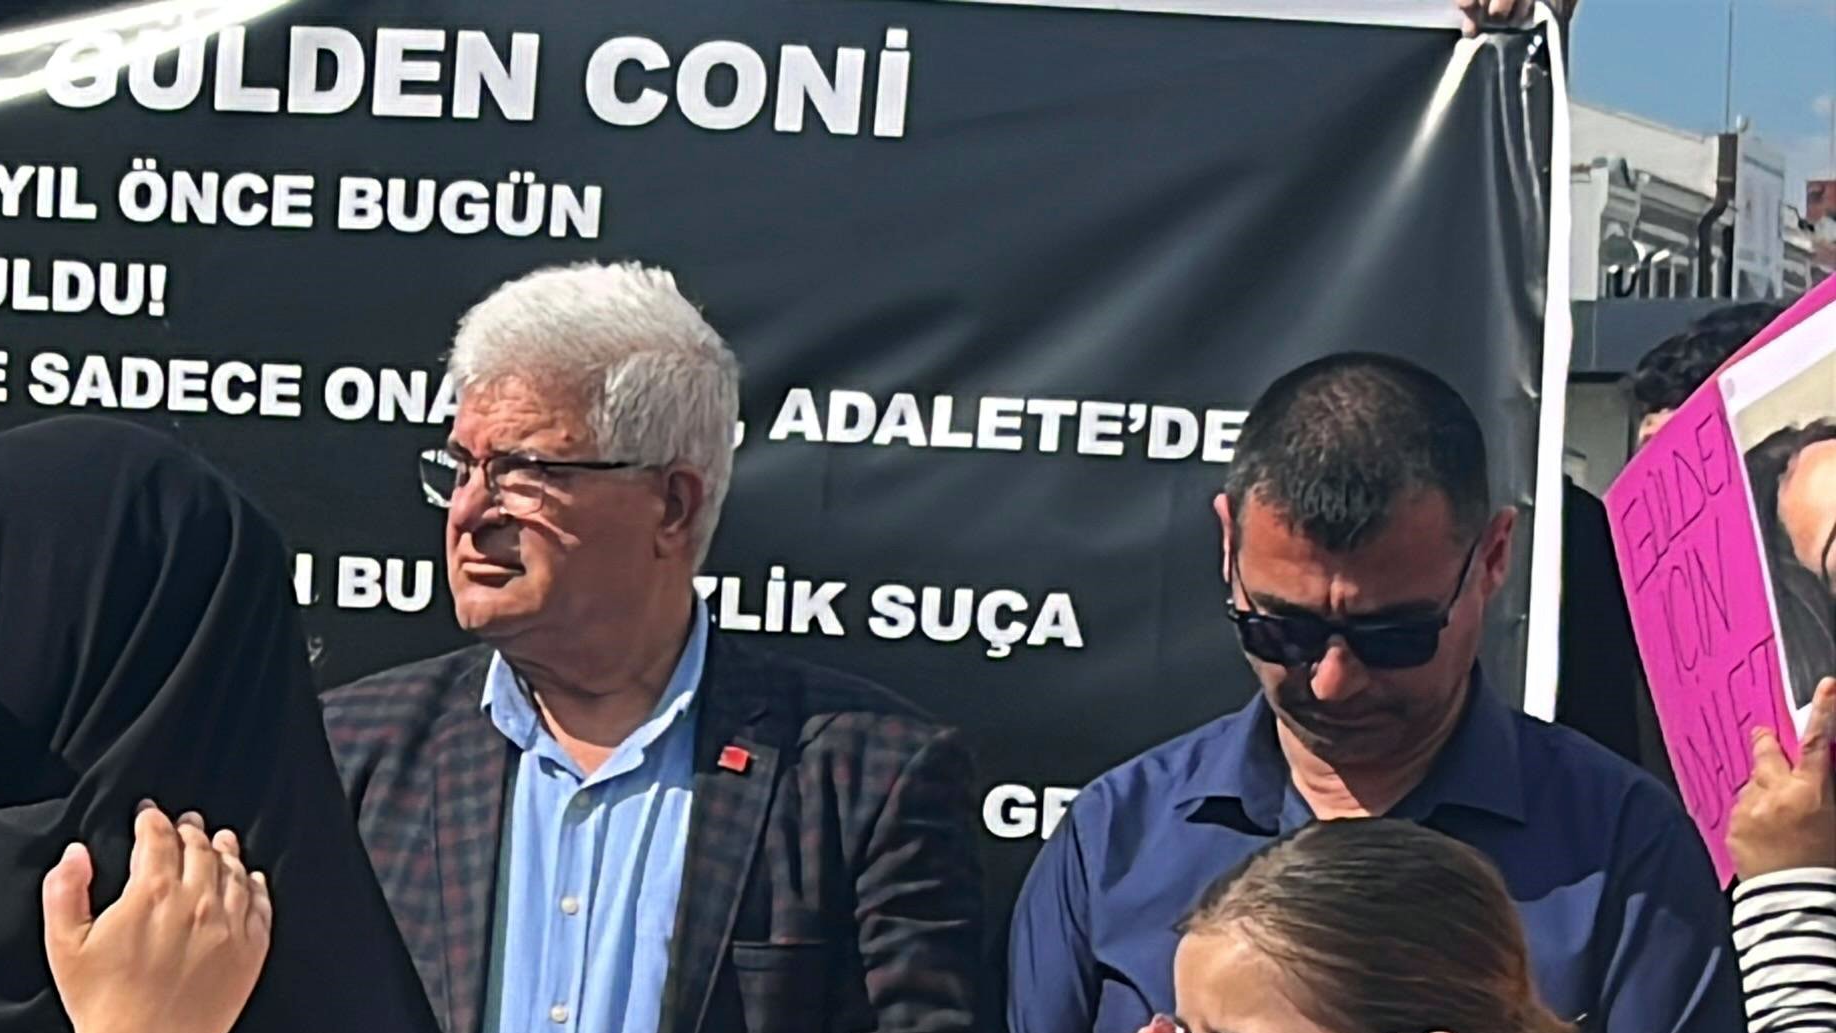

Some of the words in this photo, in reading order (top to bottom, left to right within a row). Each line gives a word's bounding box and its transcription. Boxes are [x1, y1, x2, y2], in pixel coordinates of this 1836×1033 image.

[585, 28, 911, 137] CONİ
[119, 158, 313, 229] ÖNCE
[338, 171, 602, 240] BUGÜN
[29, 353, 302, 417] SADECE
[337, 555, 434, 612] BU
[869, 587, 1086, 657] SUÇA
